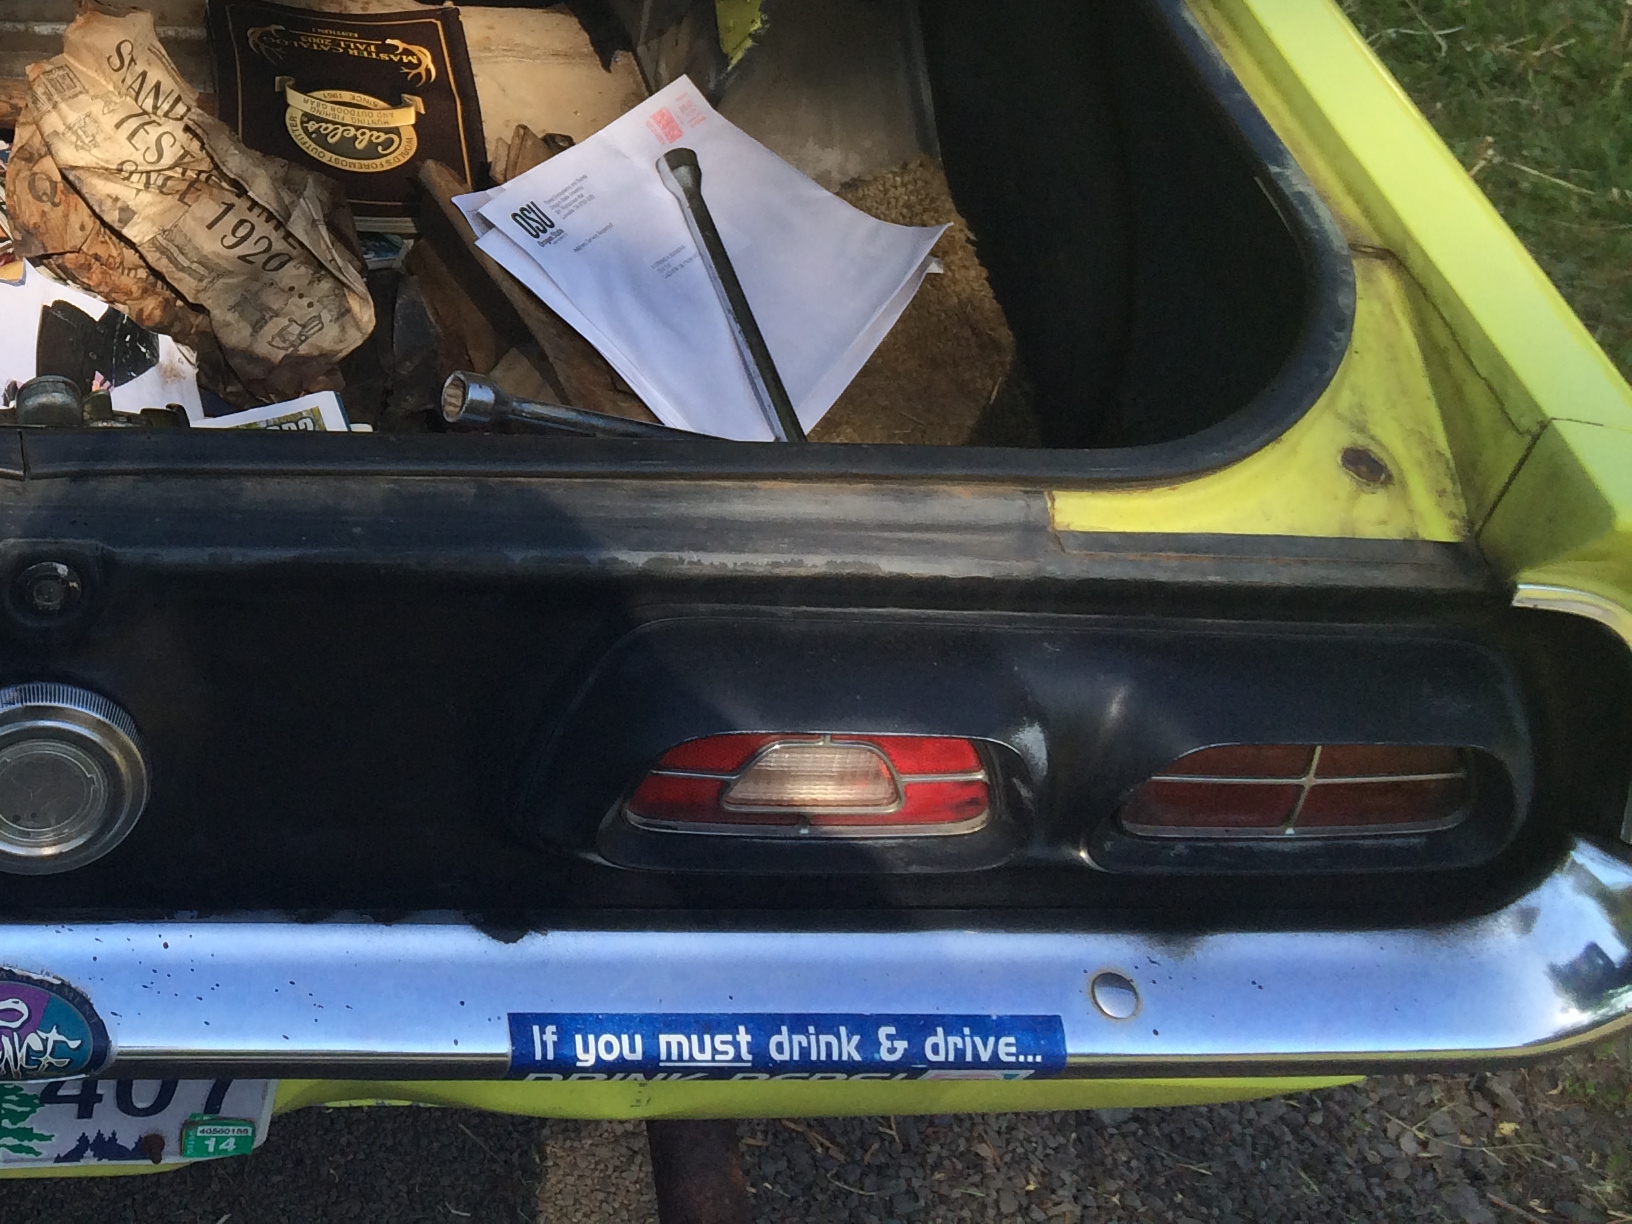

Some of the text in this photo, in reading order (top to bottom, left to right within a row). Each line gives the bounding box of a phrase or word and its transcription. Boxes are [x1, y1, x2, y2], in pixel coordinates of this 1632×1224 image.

[340, 41, 377, 52] FALL
[349, 48, 419, 64] MASTER
[349, 93, 379, 108] SINCE
[330, 106, 374, 118] OUTDOOR
[114, 111, 195, 168] TEST
[289, 116, 325, 158] OUTFITTER
[303, 120, 400, 154] Cabela's
[328, 157, 385, 170] FOREMOST
[511, 201, 555, 238] OSU
[532, 1025, 1042, 1067] If you must drink & drive...
[204, 1137, 237, 1153] 14
